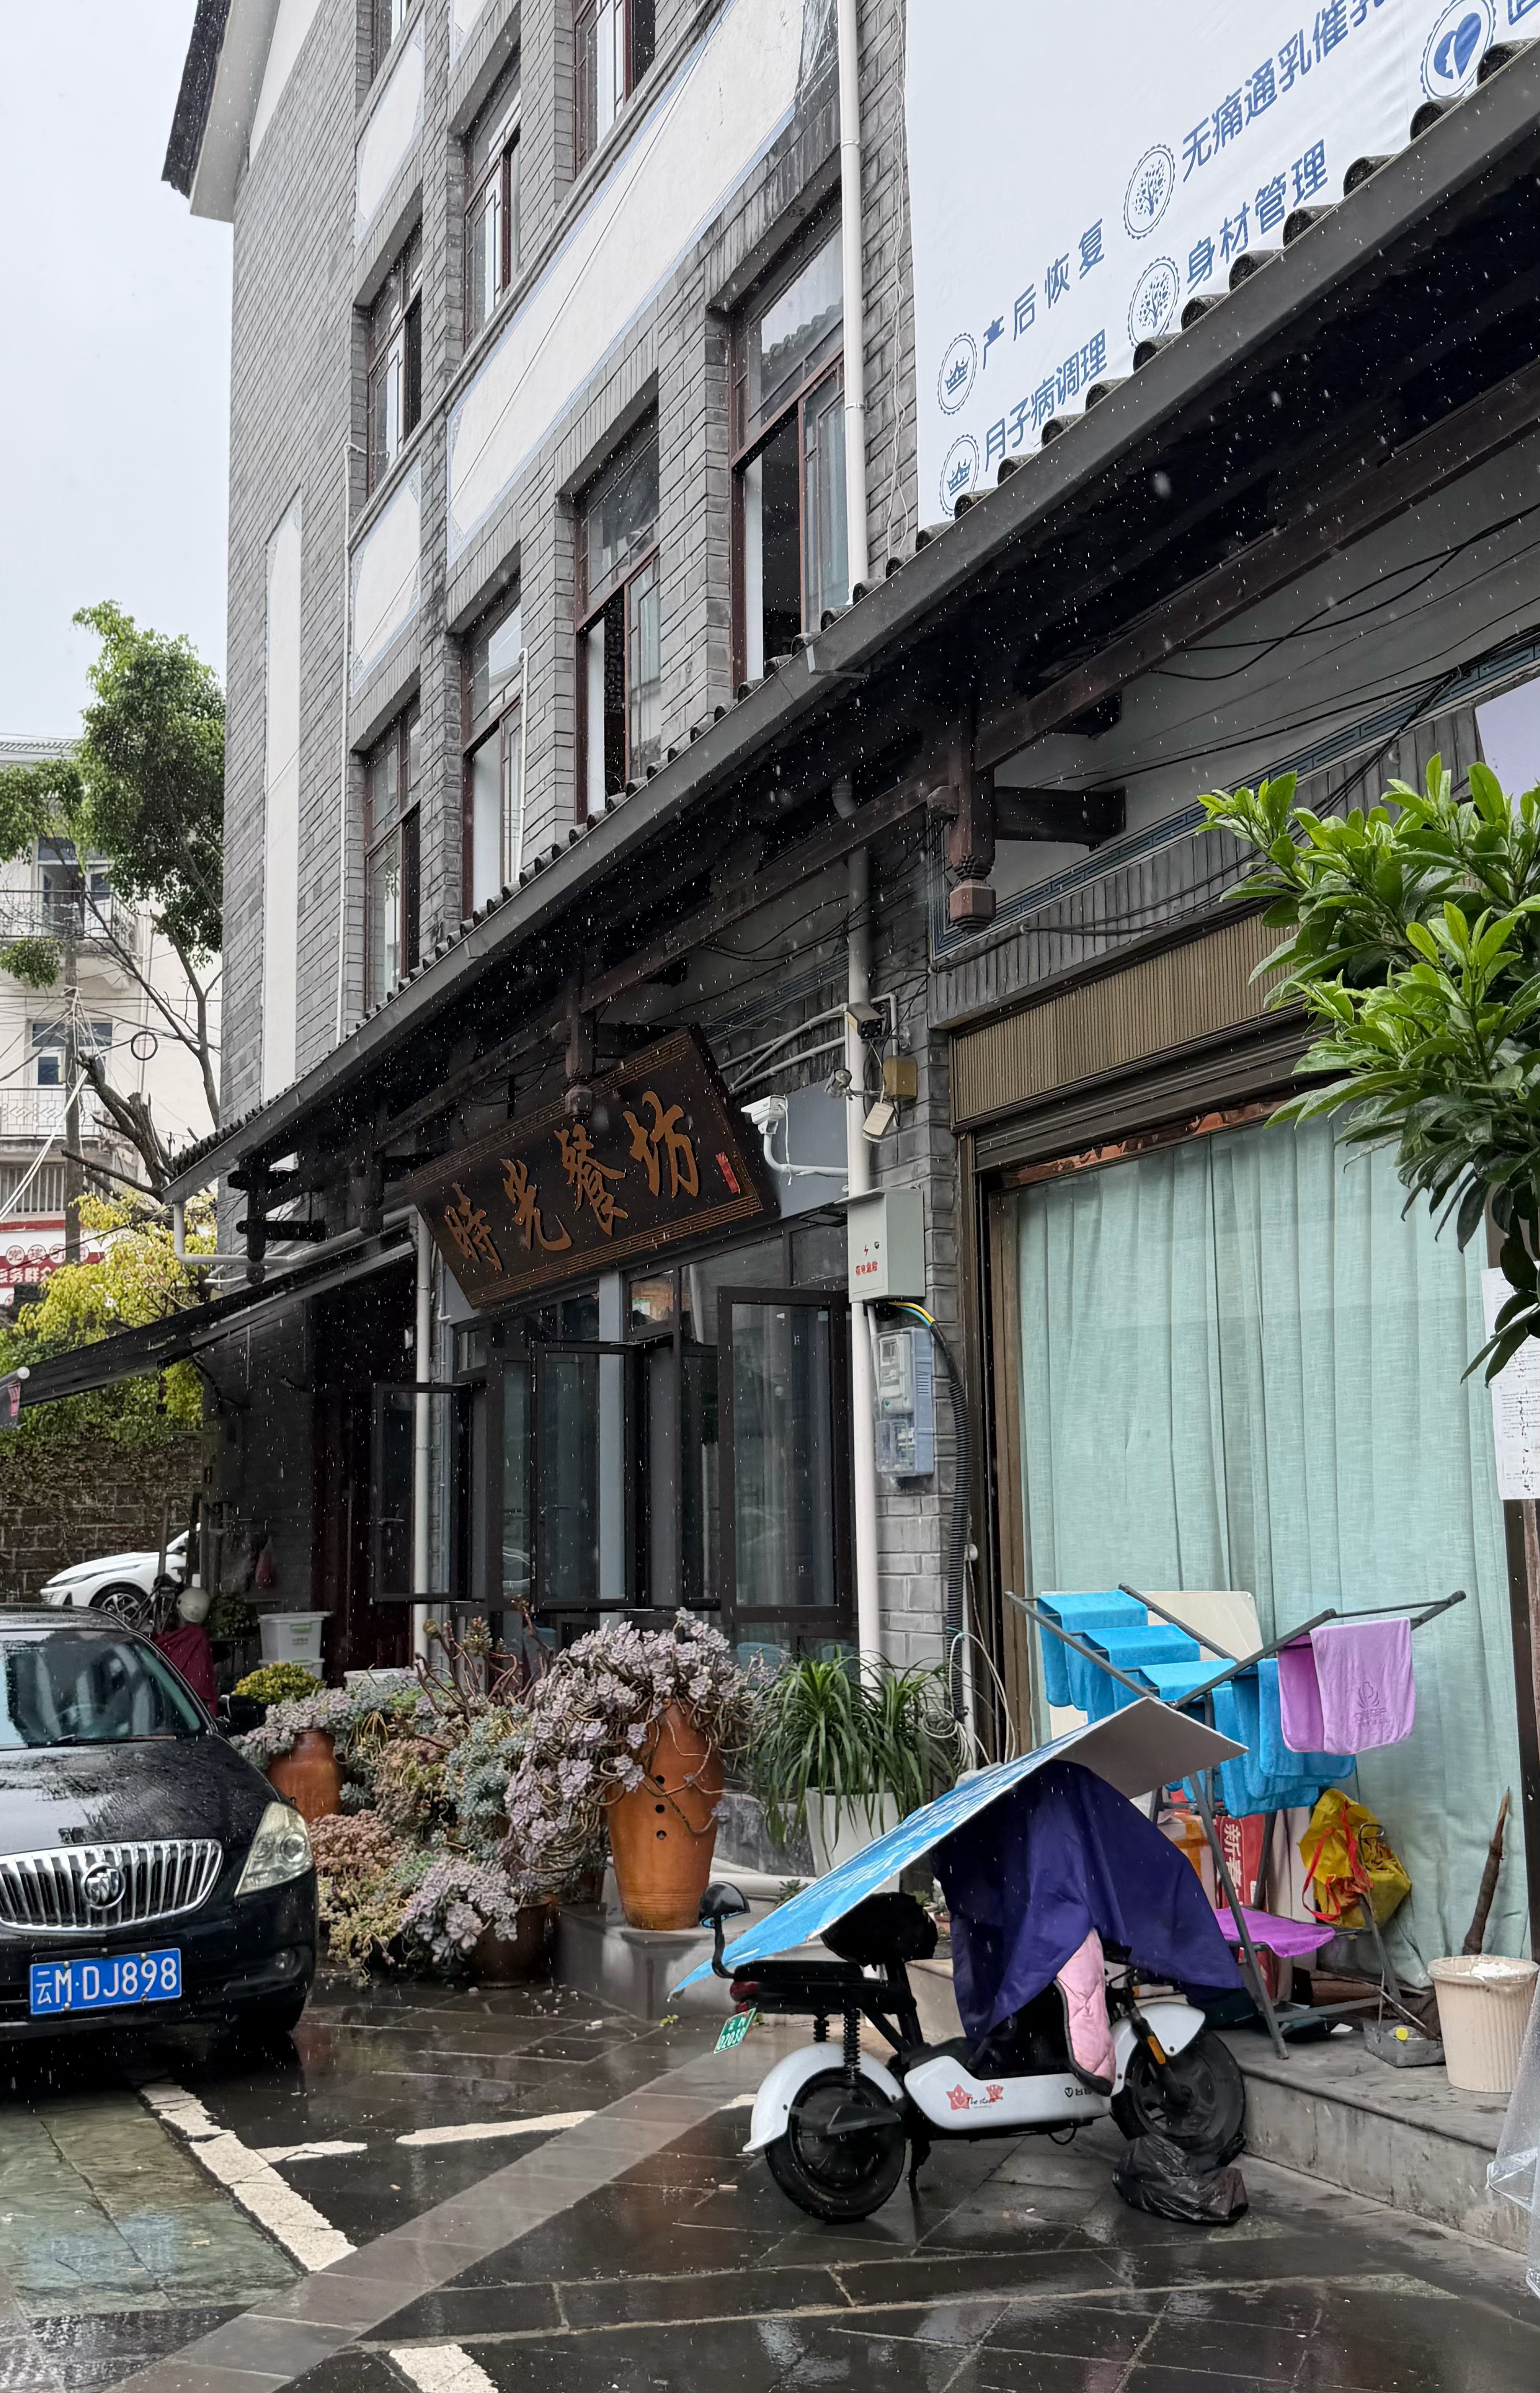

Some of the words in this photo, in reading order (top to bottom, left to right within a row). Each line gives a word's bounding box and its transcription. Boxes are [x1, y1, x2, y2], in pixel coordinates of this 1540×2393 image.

[1187, 138, 1329, 294] 身材管理
[982, 218, 1105, 369] 产后恢复
[984, 328, 1107, 472] 月子病调理
